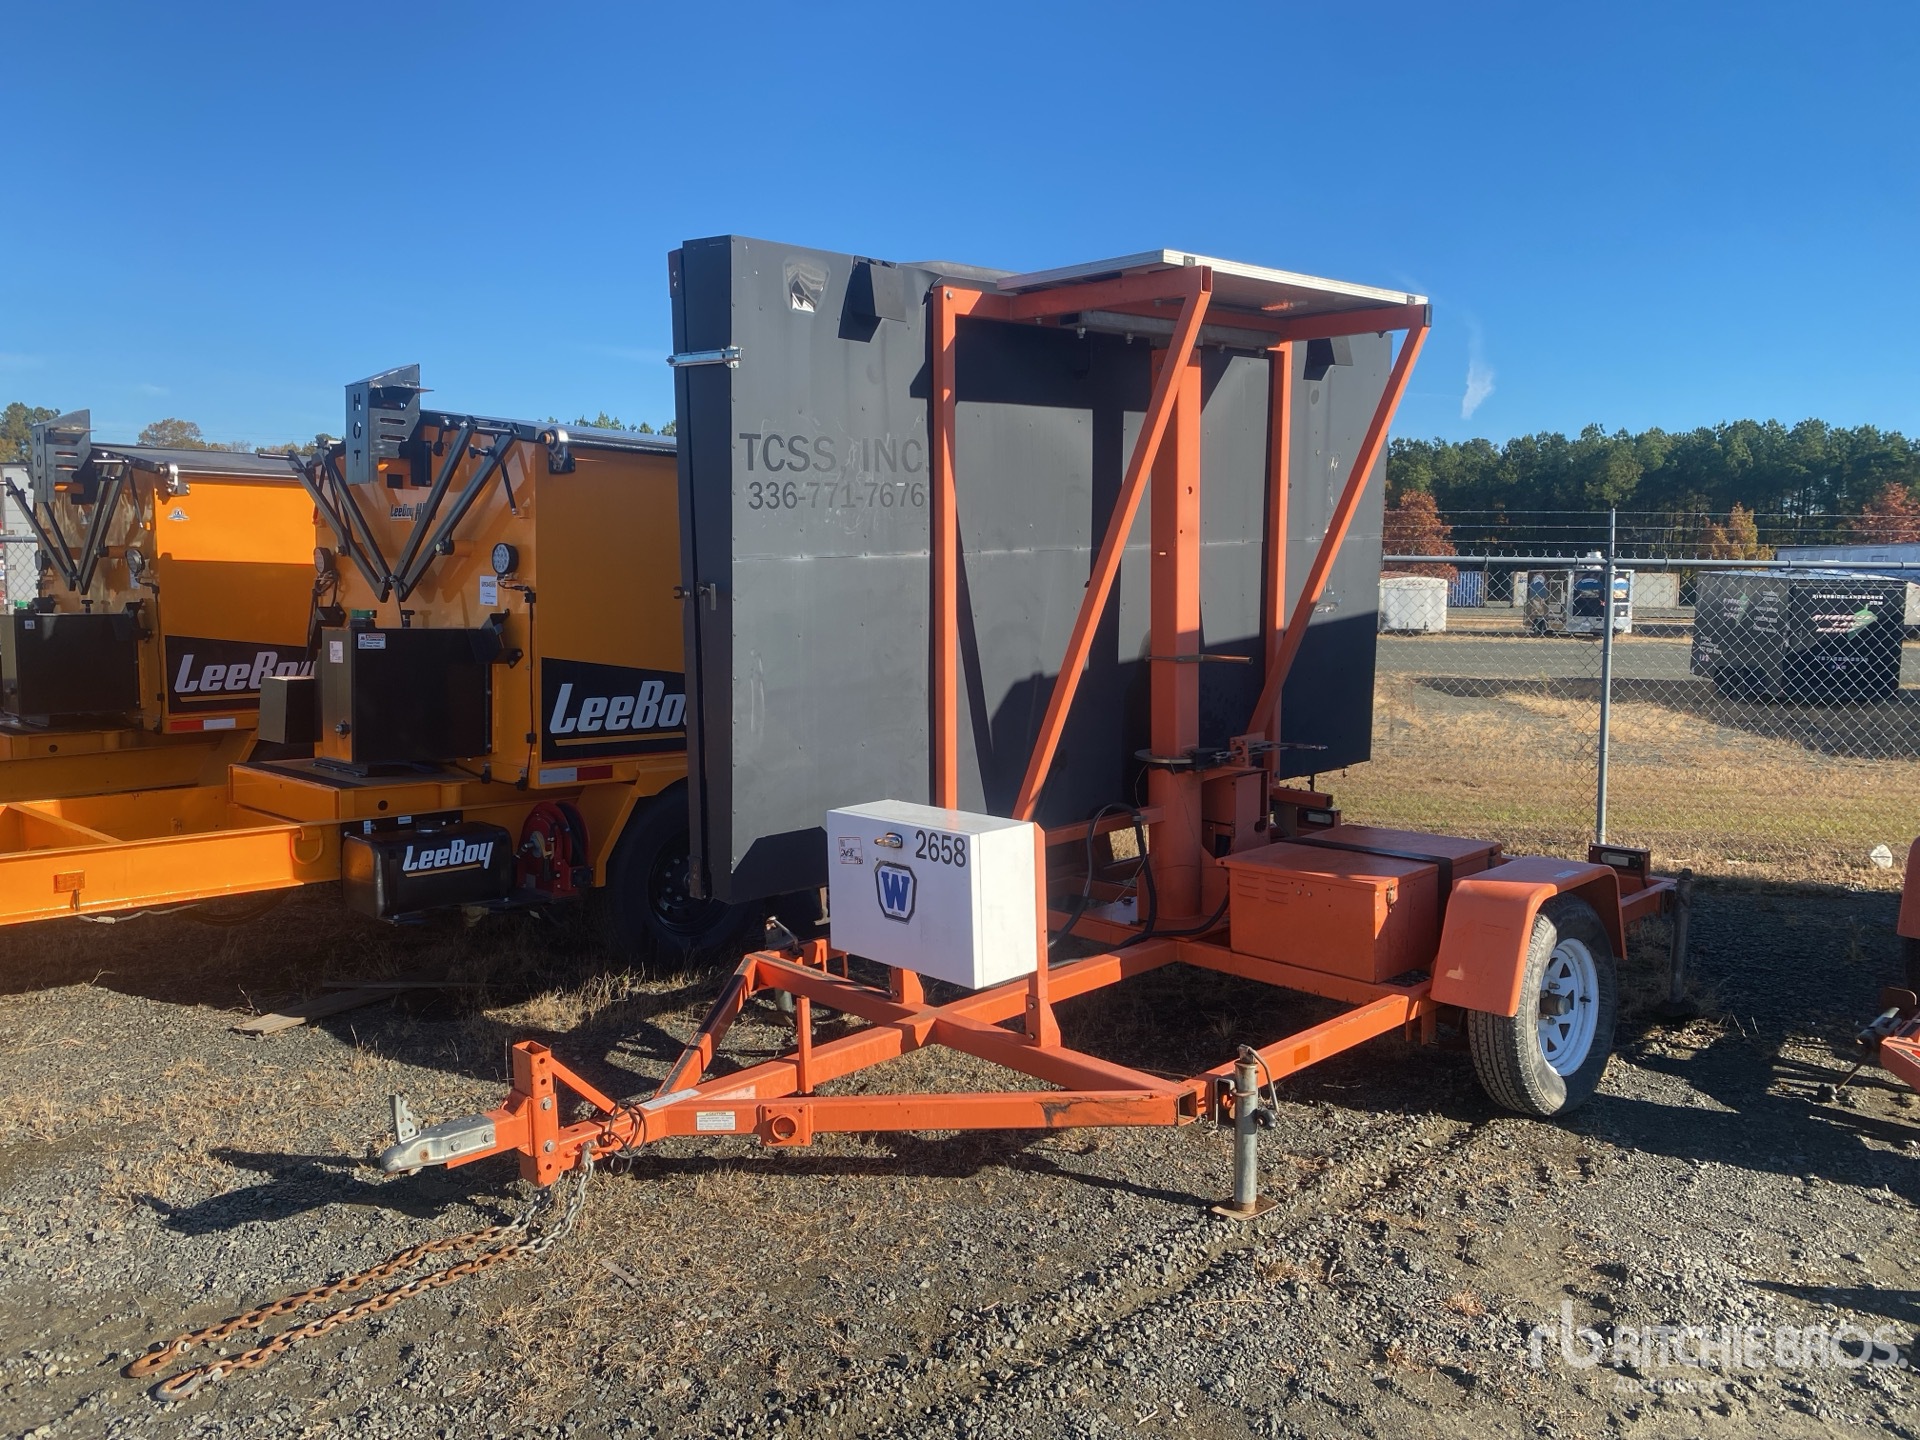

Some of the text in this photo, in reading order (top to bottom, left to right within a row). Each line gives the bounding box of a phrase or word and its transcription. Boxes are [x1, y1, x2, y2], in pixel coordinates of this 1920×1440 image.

[748, 481, 926, 510] 336-771-7676
[549, 681, 687, 733] LeeBo
[402, 839, 493, 871] LeeBoy
[915, 830, 967, 868] 2658
